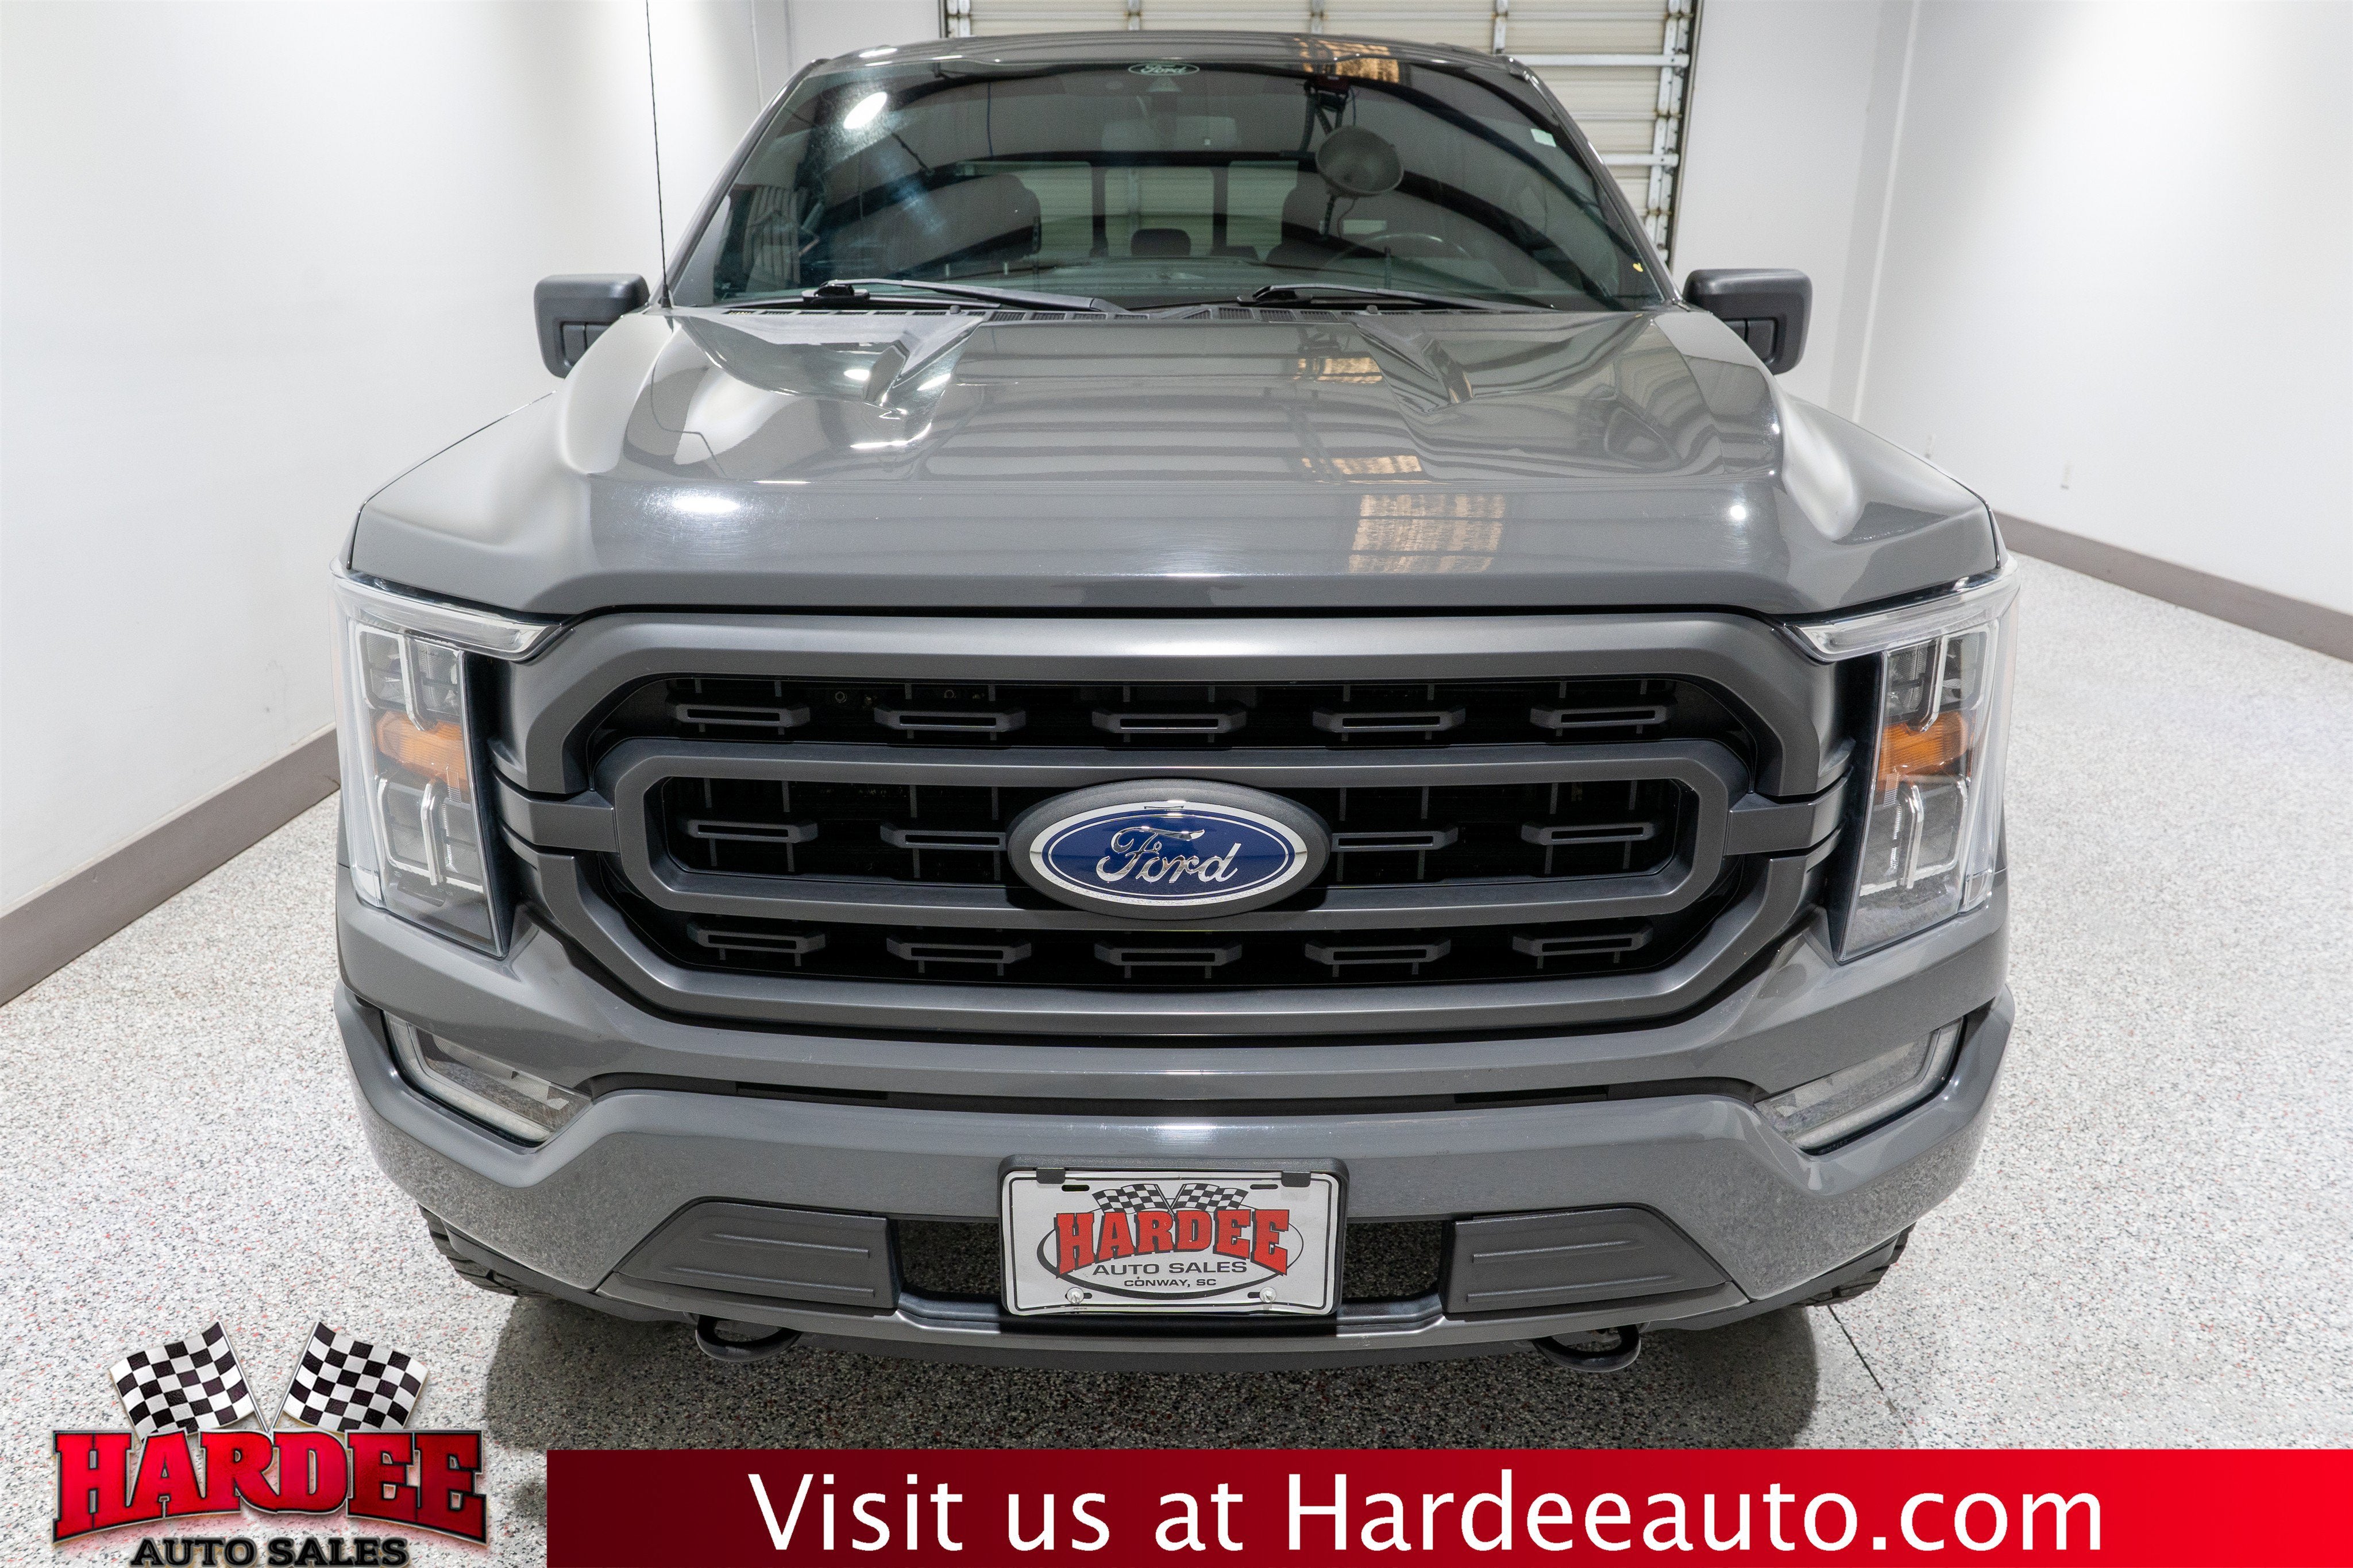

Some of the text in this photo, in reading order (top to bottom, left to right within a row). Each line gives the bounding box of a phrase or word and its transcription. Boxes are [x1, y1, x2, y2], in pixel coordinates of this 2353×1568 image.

[1141, 63, 1187, 74] Ford
[1096, 826, 1241, 883] Ford
[1054, 1209, 1290, 1278] HARDEE
[1092, 1261, 1247, 1276] AUTO SALES
[1124, 1279, 1191, 1288] CONWAY,
